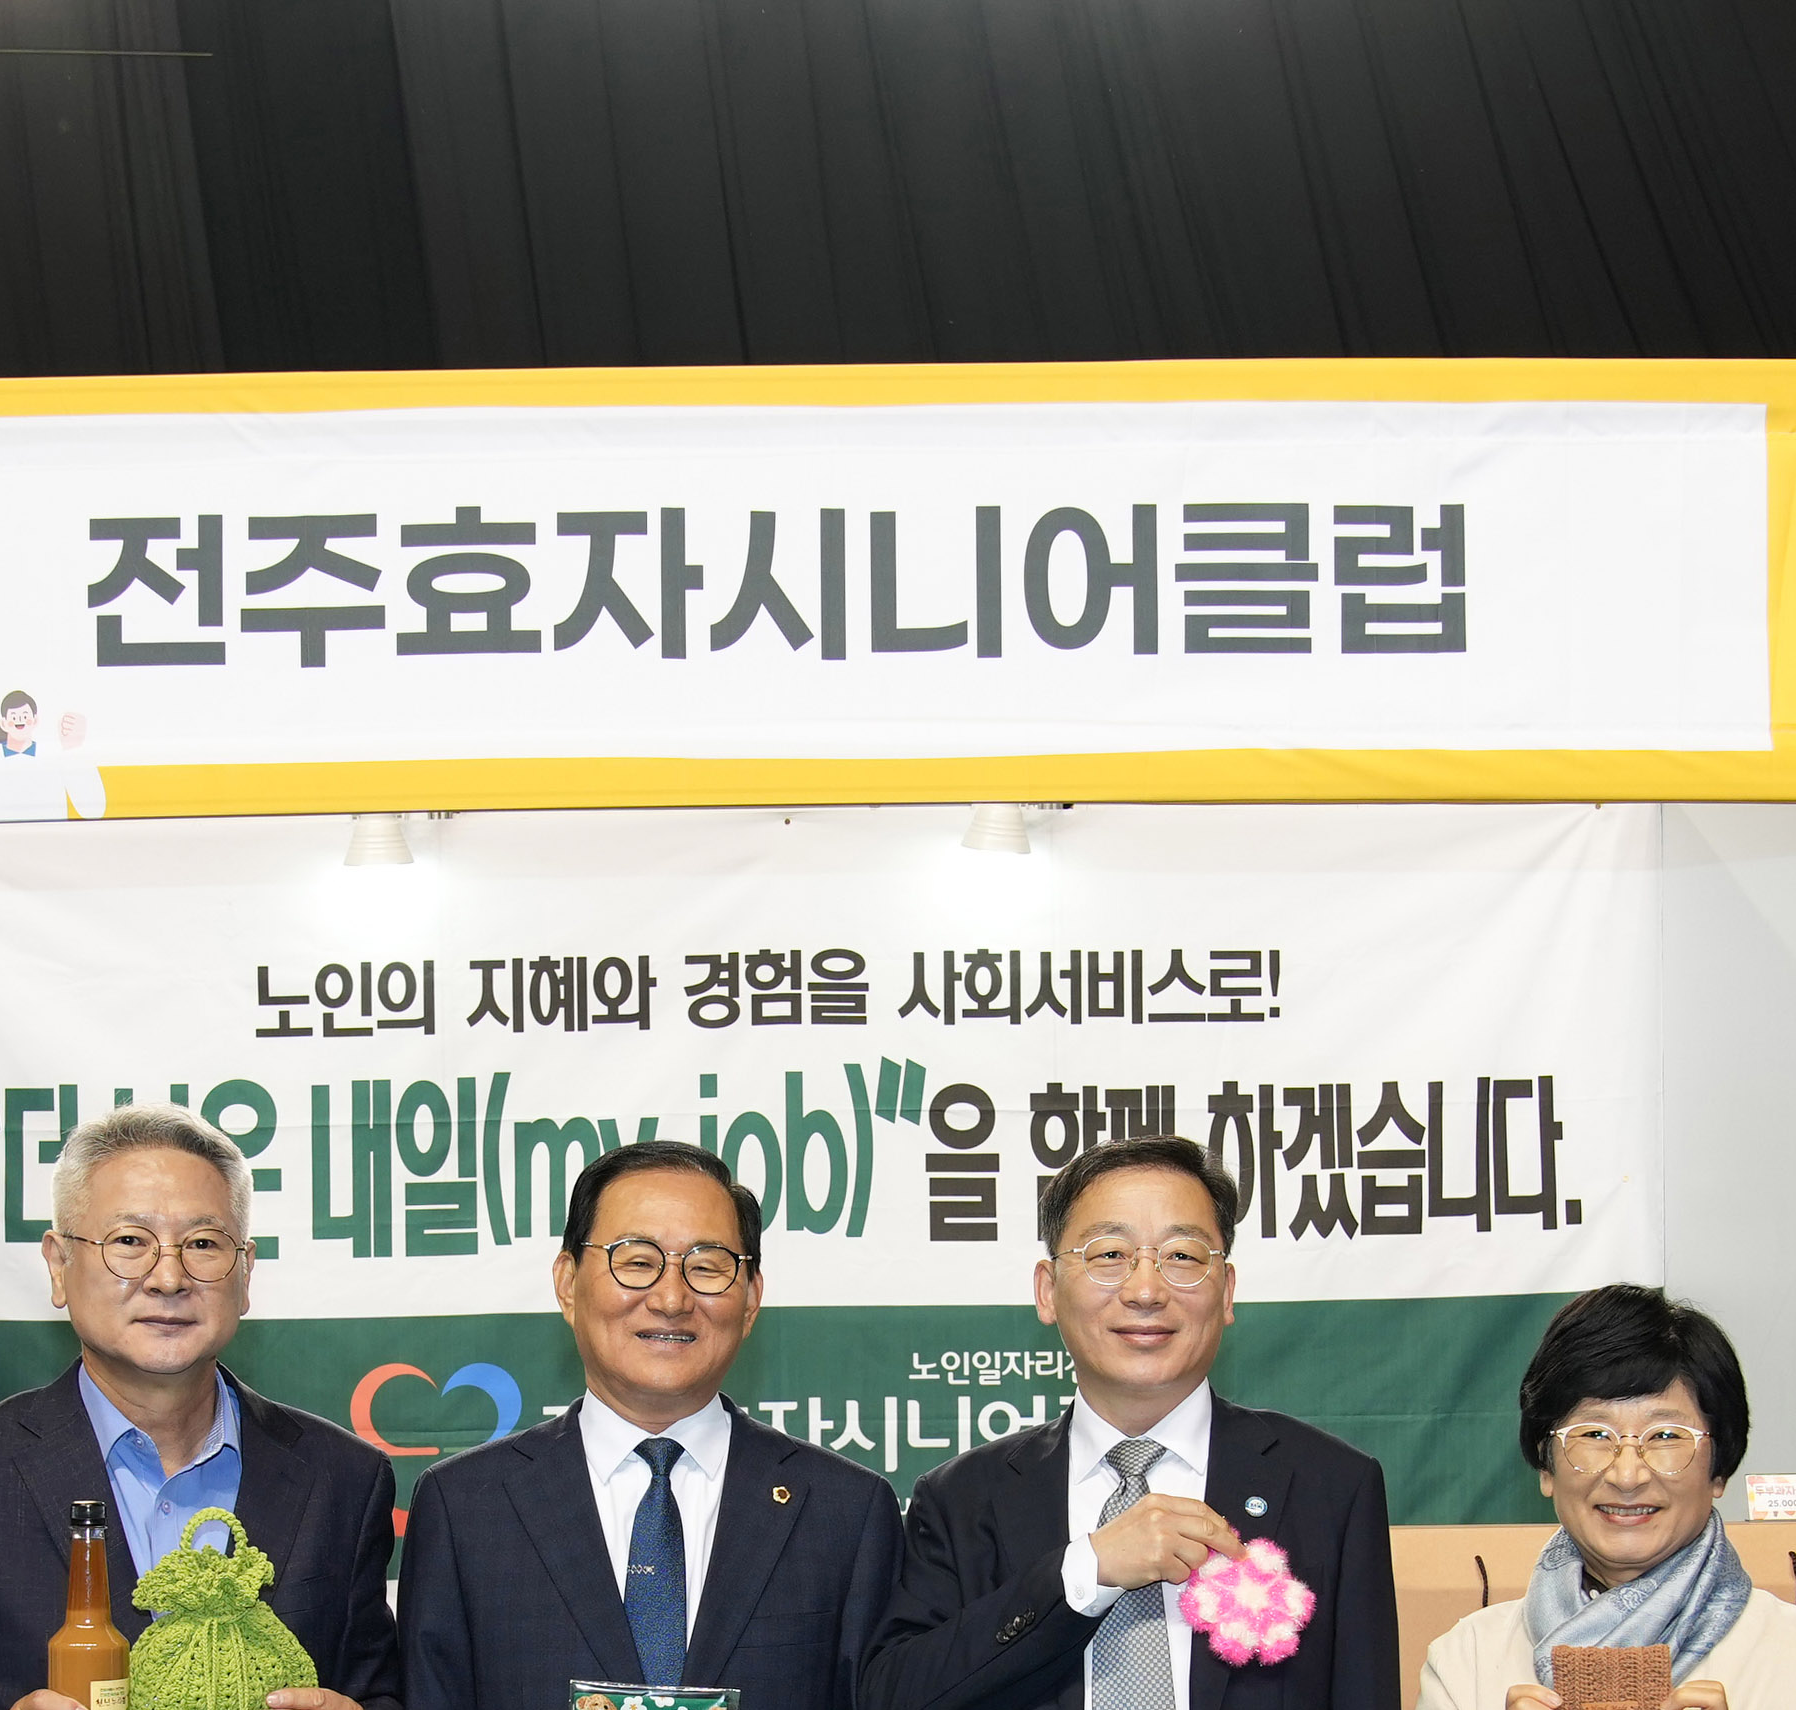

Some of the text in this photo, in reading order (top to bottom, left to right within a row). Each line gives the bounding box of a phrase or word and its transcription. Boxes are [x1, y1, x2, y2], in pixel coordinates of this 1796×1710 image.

[86, 502, 1468, 669] 전주효자시니어클럽
[255, 948, 1282, 1038] 노인의 지혜와 경험을 사회서비스로!
[311, 1071, 659, 1258] 내일(m
[1207, 1075, 1583, 1243] 하겠습니다.
